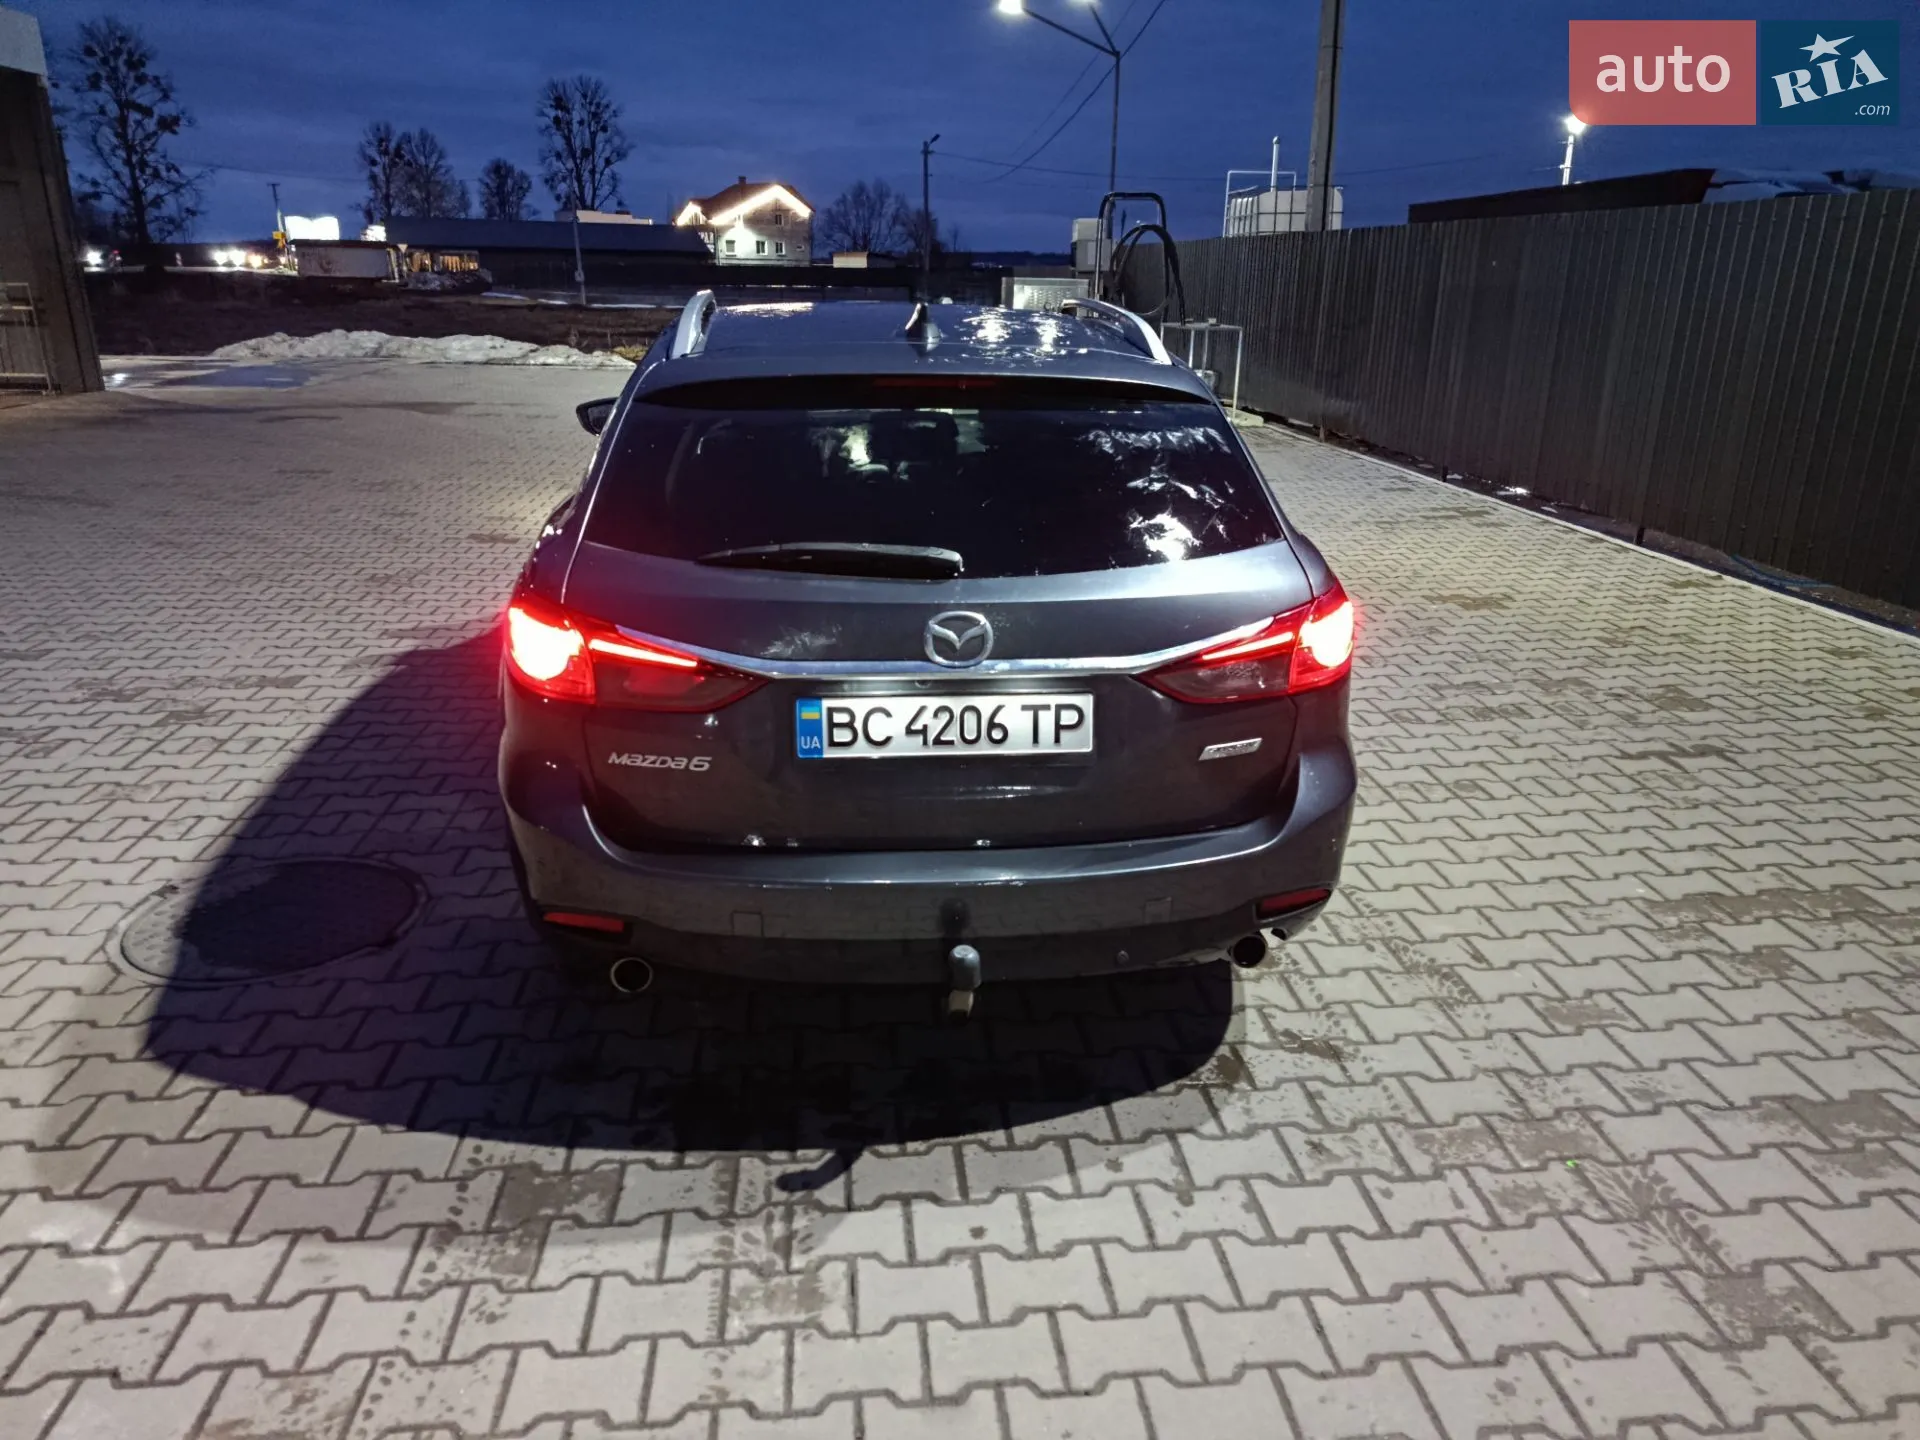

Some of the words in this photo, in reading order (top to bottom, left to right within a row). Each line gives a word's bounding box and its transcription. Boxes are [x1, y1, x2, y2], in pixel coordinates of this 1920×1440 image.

[826, 706, 893, 748] BC
[905, 704, 1009, 747] 4206
[1020, 703, 1085, 745] TP
[801, 735, 821, 749] UA
